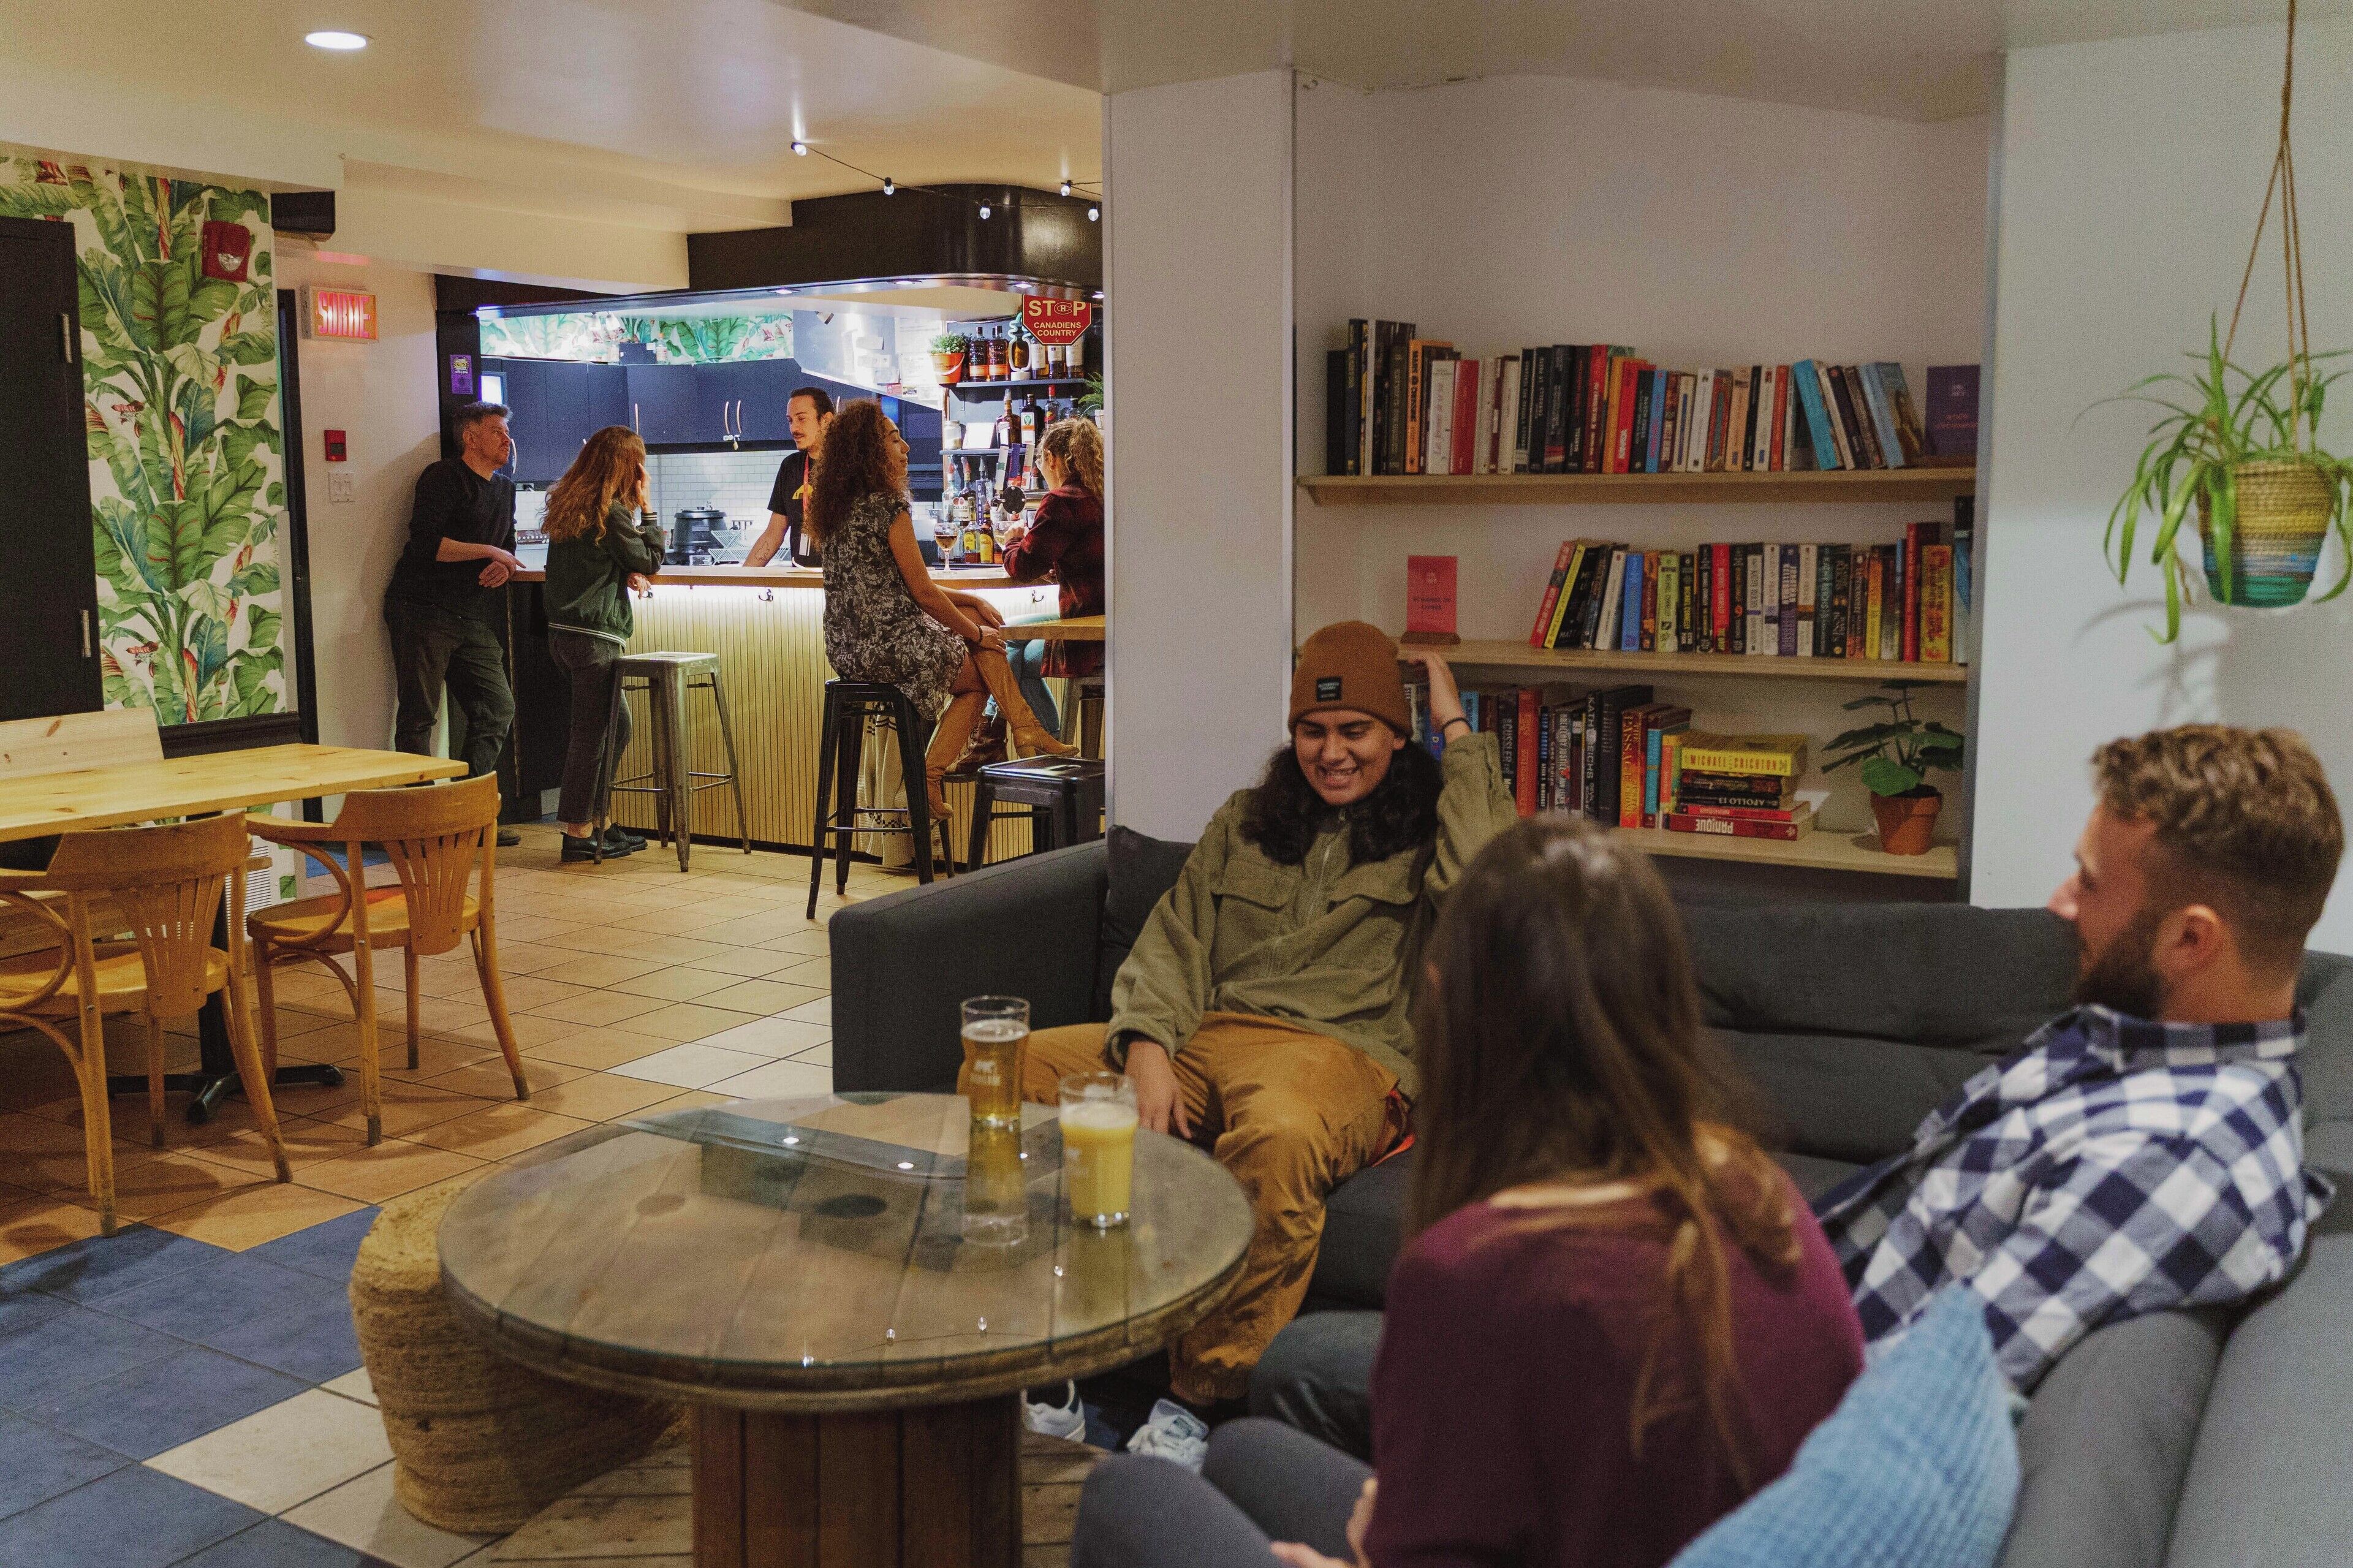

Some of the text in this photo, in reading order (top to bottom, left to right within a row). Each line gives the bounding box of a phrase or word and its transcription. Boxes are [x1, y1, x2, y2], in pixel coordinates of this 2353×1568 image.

[318, 291, 370, 338] SORTIE
[1682, 585, 1691, 629] MICHAEL CONNELLY
[1501, 723, 1514, 762] CUSSLER
[1622, 715, 1634, 778] PASSAGE
[1689, 754, 1776, 771] MICHAEL CRICHTON
[1729, 797, 1765, 806] APOLLO
[1694, 817, 1734, 833] PANIQUE
